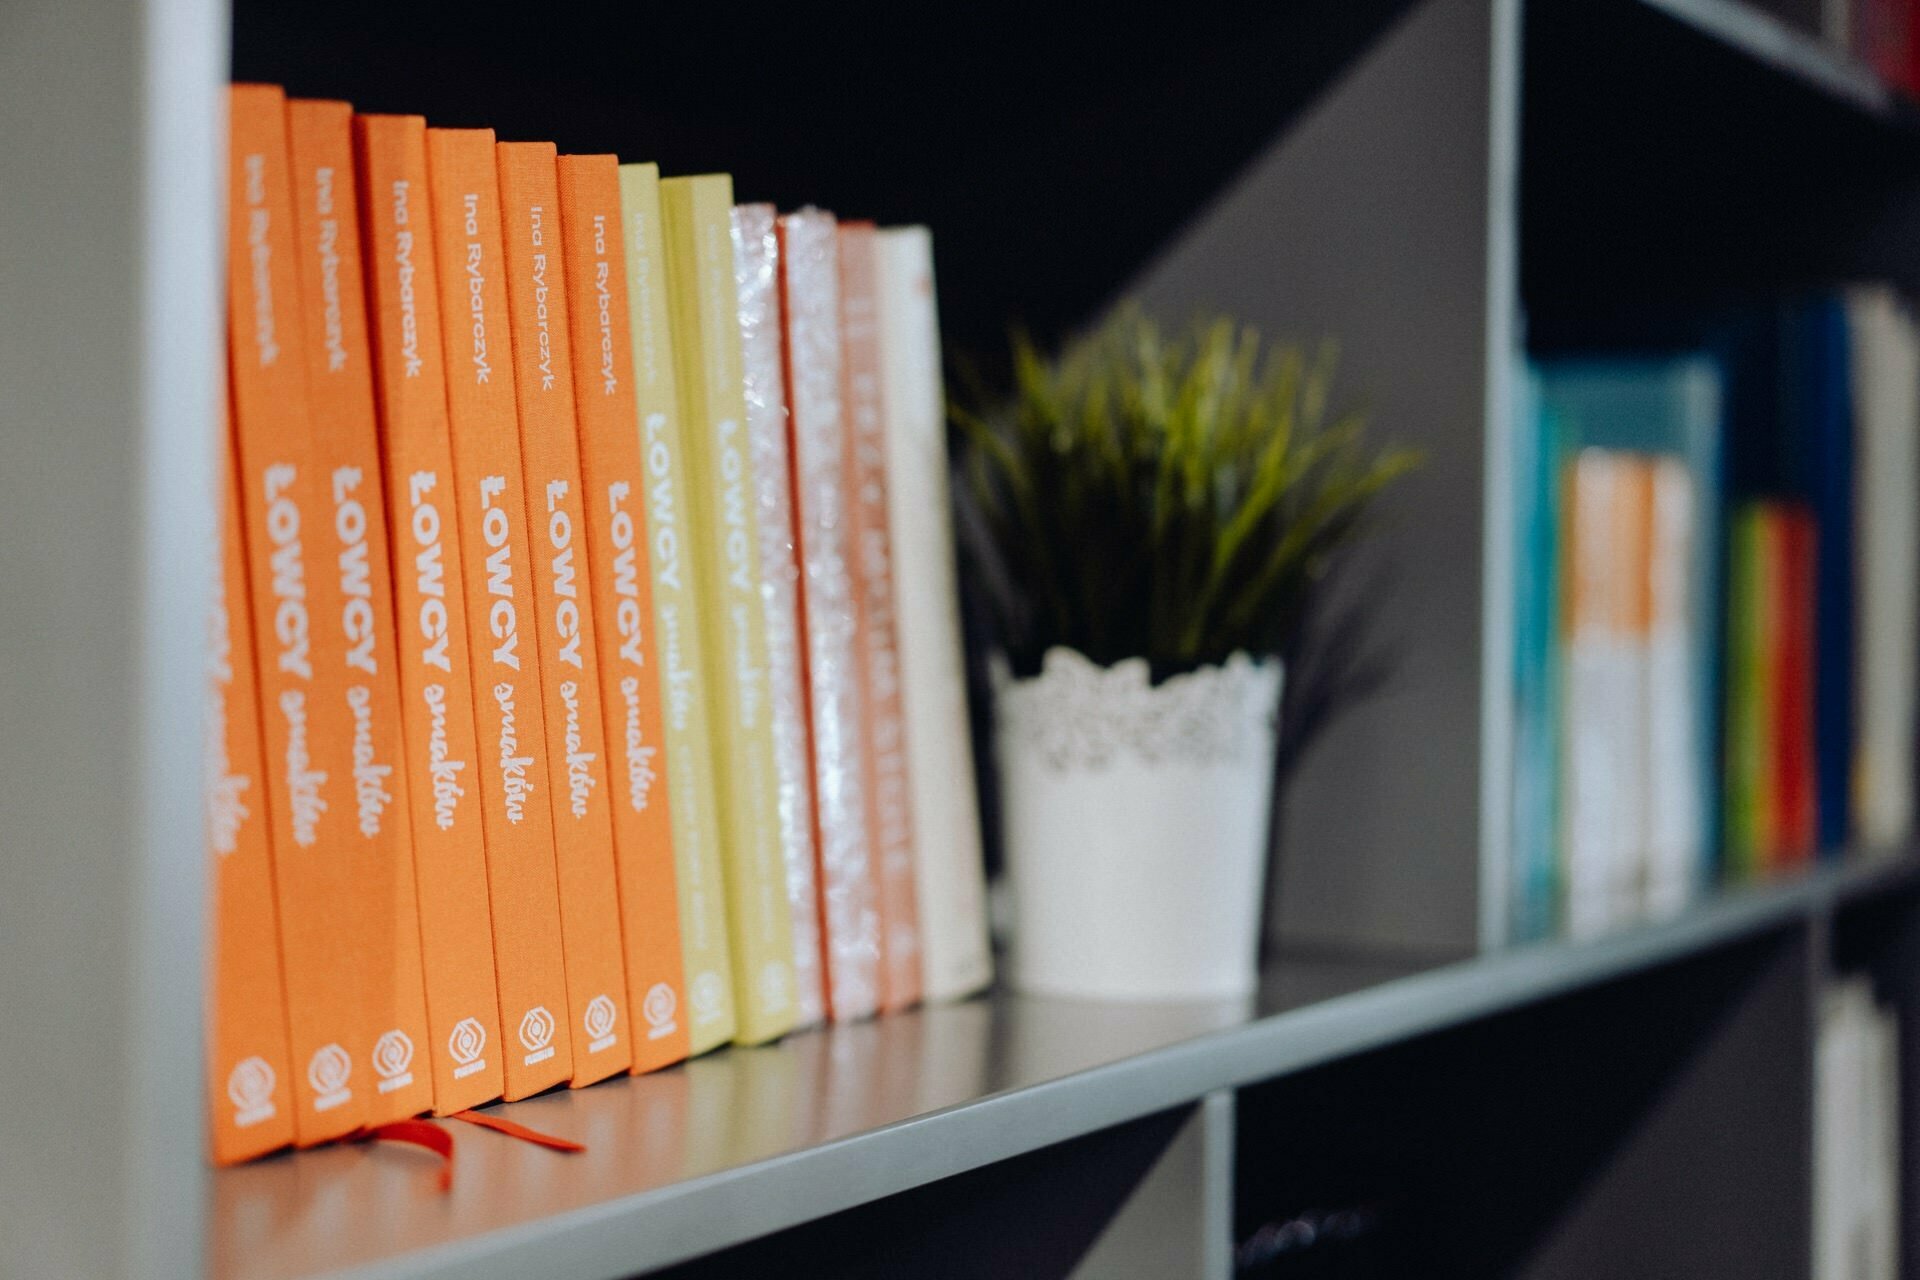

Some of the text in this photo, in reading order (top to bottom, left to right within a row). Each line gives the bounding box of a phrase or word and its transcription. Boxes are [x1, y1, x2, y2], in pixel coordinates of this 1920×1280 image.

[394, 181, 422, 377] Ina Rybarczyk
[464, 194, 491, 384] Ina Rybarczyk
[531, 207, 554, 390] Ina Rybarczyk
[594, 216, 617, 395] Ina Rybarczyk
[264, 464, 312, 679] ŁOWCY
[333, 467, 376, 674] ŁOWCY
[410, 471, 451, 672] ŁOWCY
[646, 413, 682, 590] ŁOWCY
[480, 476, 534, 824] ŁOWCY smaków
[547, 480, 596, 818] ŁOWCY smaków
[608, 481, 656, 812] ŁOWCY smaków
